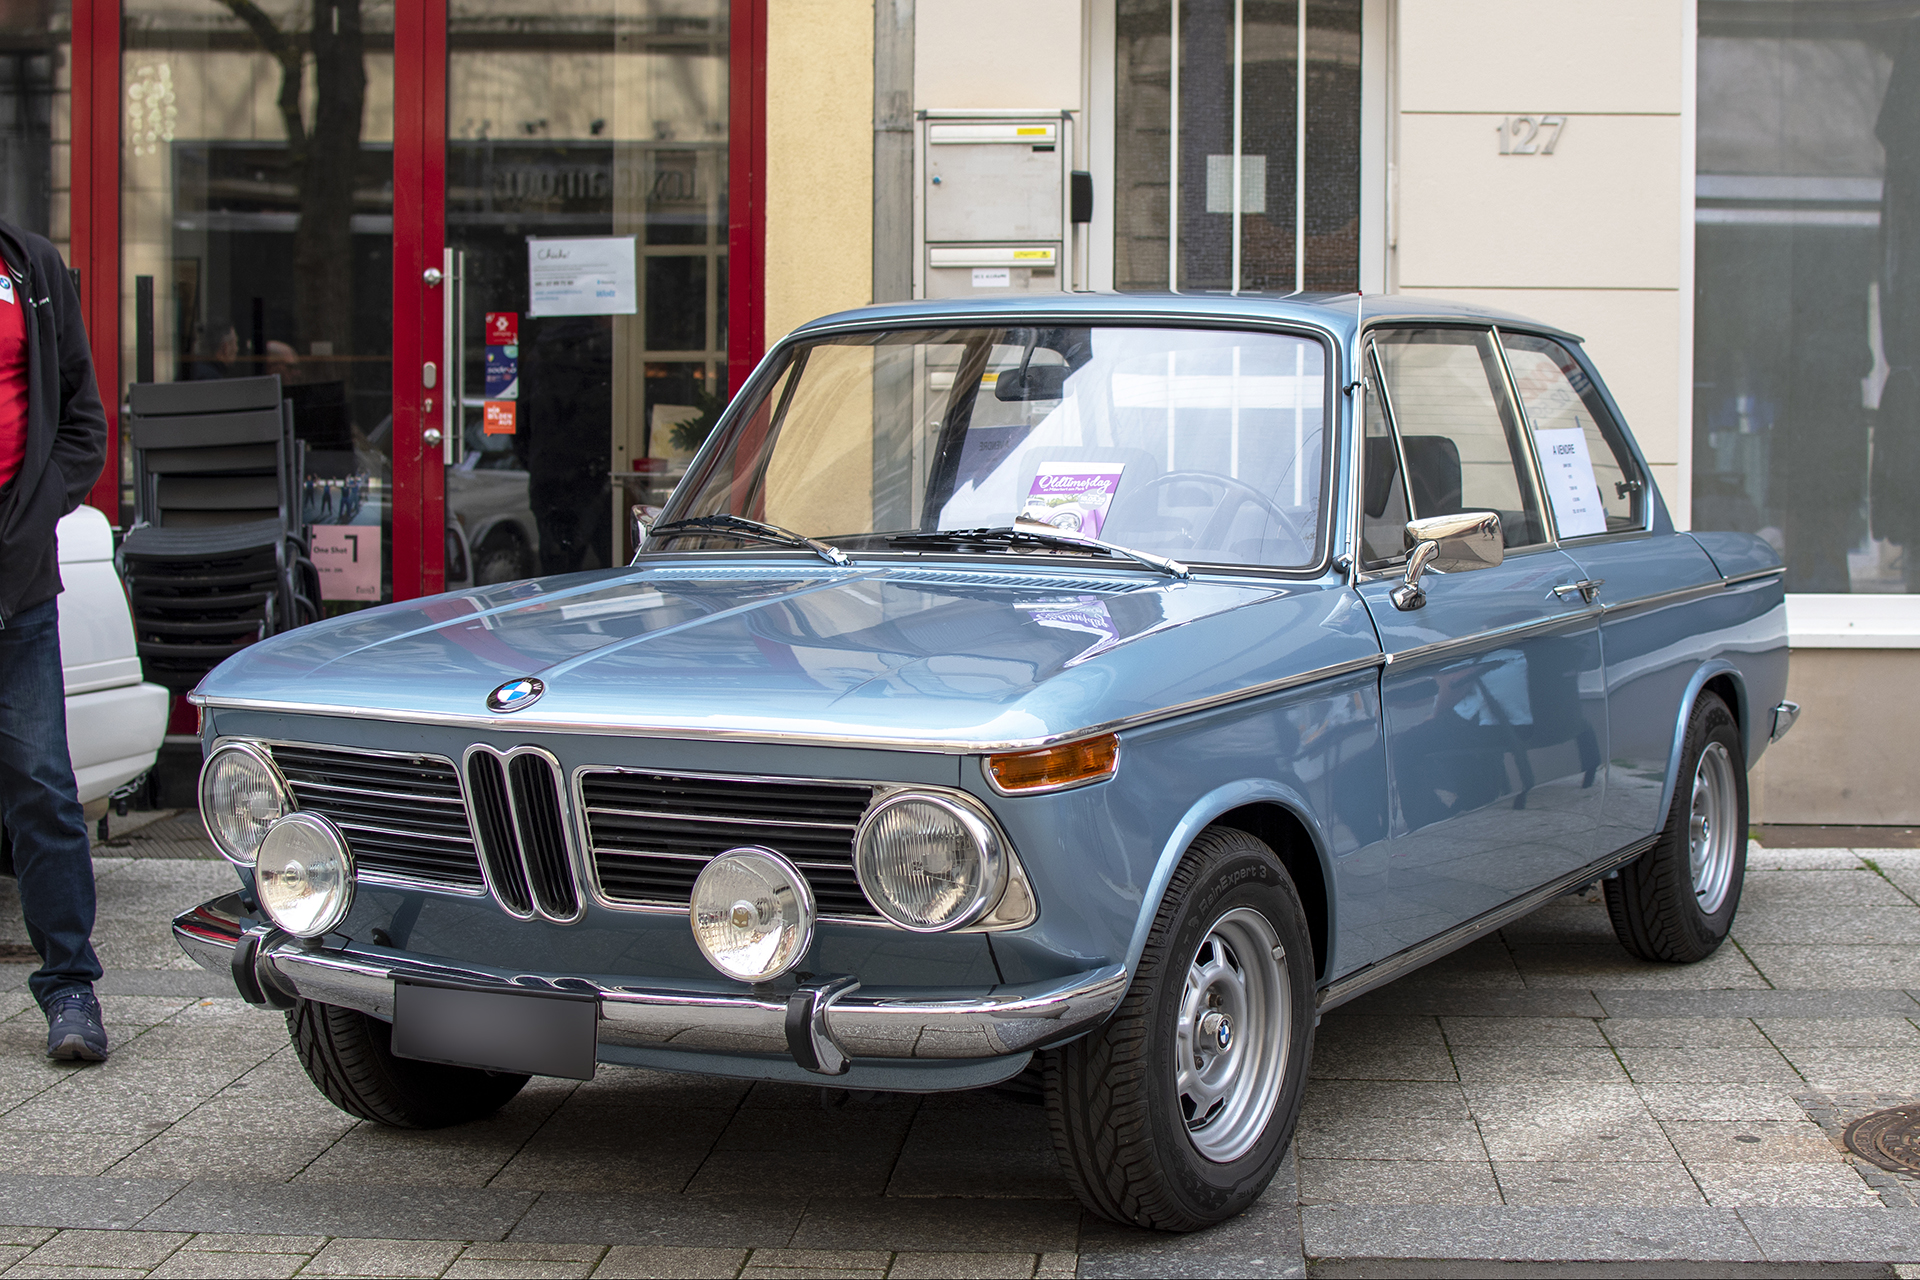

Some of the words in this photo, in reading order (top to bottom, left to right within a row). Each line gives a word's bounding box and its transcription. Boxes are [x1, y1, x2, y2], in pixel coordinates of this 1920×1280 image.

[1496, 116, 1567, 155] 127
[1557, 443, 1575, 455] VENDRE
[1038, 474, 1112, 494] Oldtimerdag
[313, 546, 328, 554] One
[330, 546, 347, 555] Shot
[1198, 865, 1257, 915] RainExpert
[1259, 865, 1267, 879] 3
[1236, 1187, 1254, 1201] TYRE
